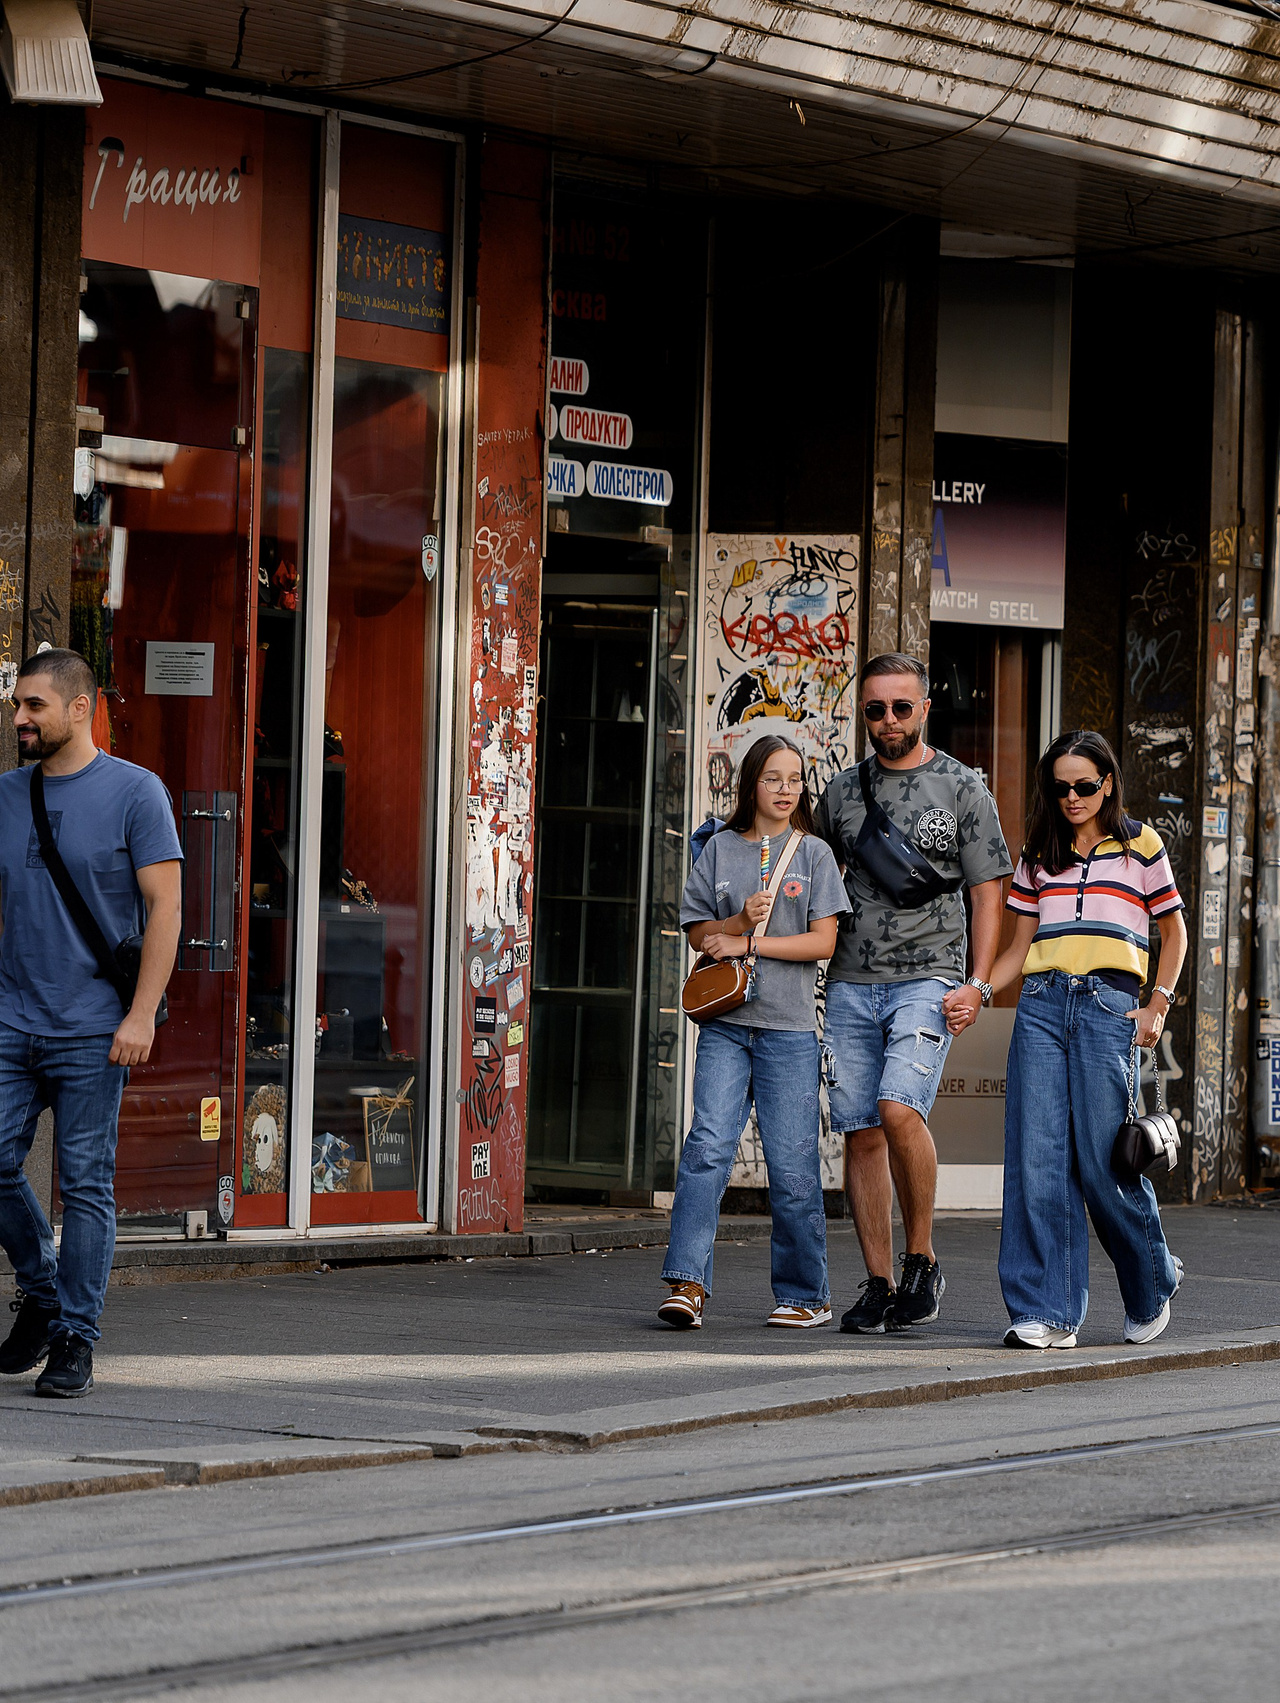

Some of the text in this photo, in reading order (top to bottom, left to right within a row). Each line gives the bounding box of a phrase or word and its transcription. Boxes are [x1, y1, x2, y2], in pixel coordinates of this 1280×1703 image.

[87, 136, 242, 223] Грация
[550, 359, 583, 393] АЛНИ
[566, 409, 627, 447] ПРОДУКТИ
[594, 464, 665, 502] ХОЛЕСТЕРОЛ
[932, 480, 986, 504] LLERY
[930, 590, 1039, 621] WATCH STEEL
[919, 810, 956, 836] BROKEN HEARTS
[975, 1079, 1007, 1093] JEWE
[472, 1143, 489, 1161] PAY
[473, 1160, 488, 1178] ME
